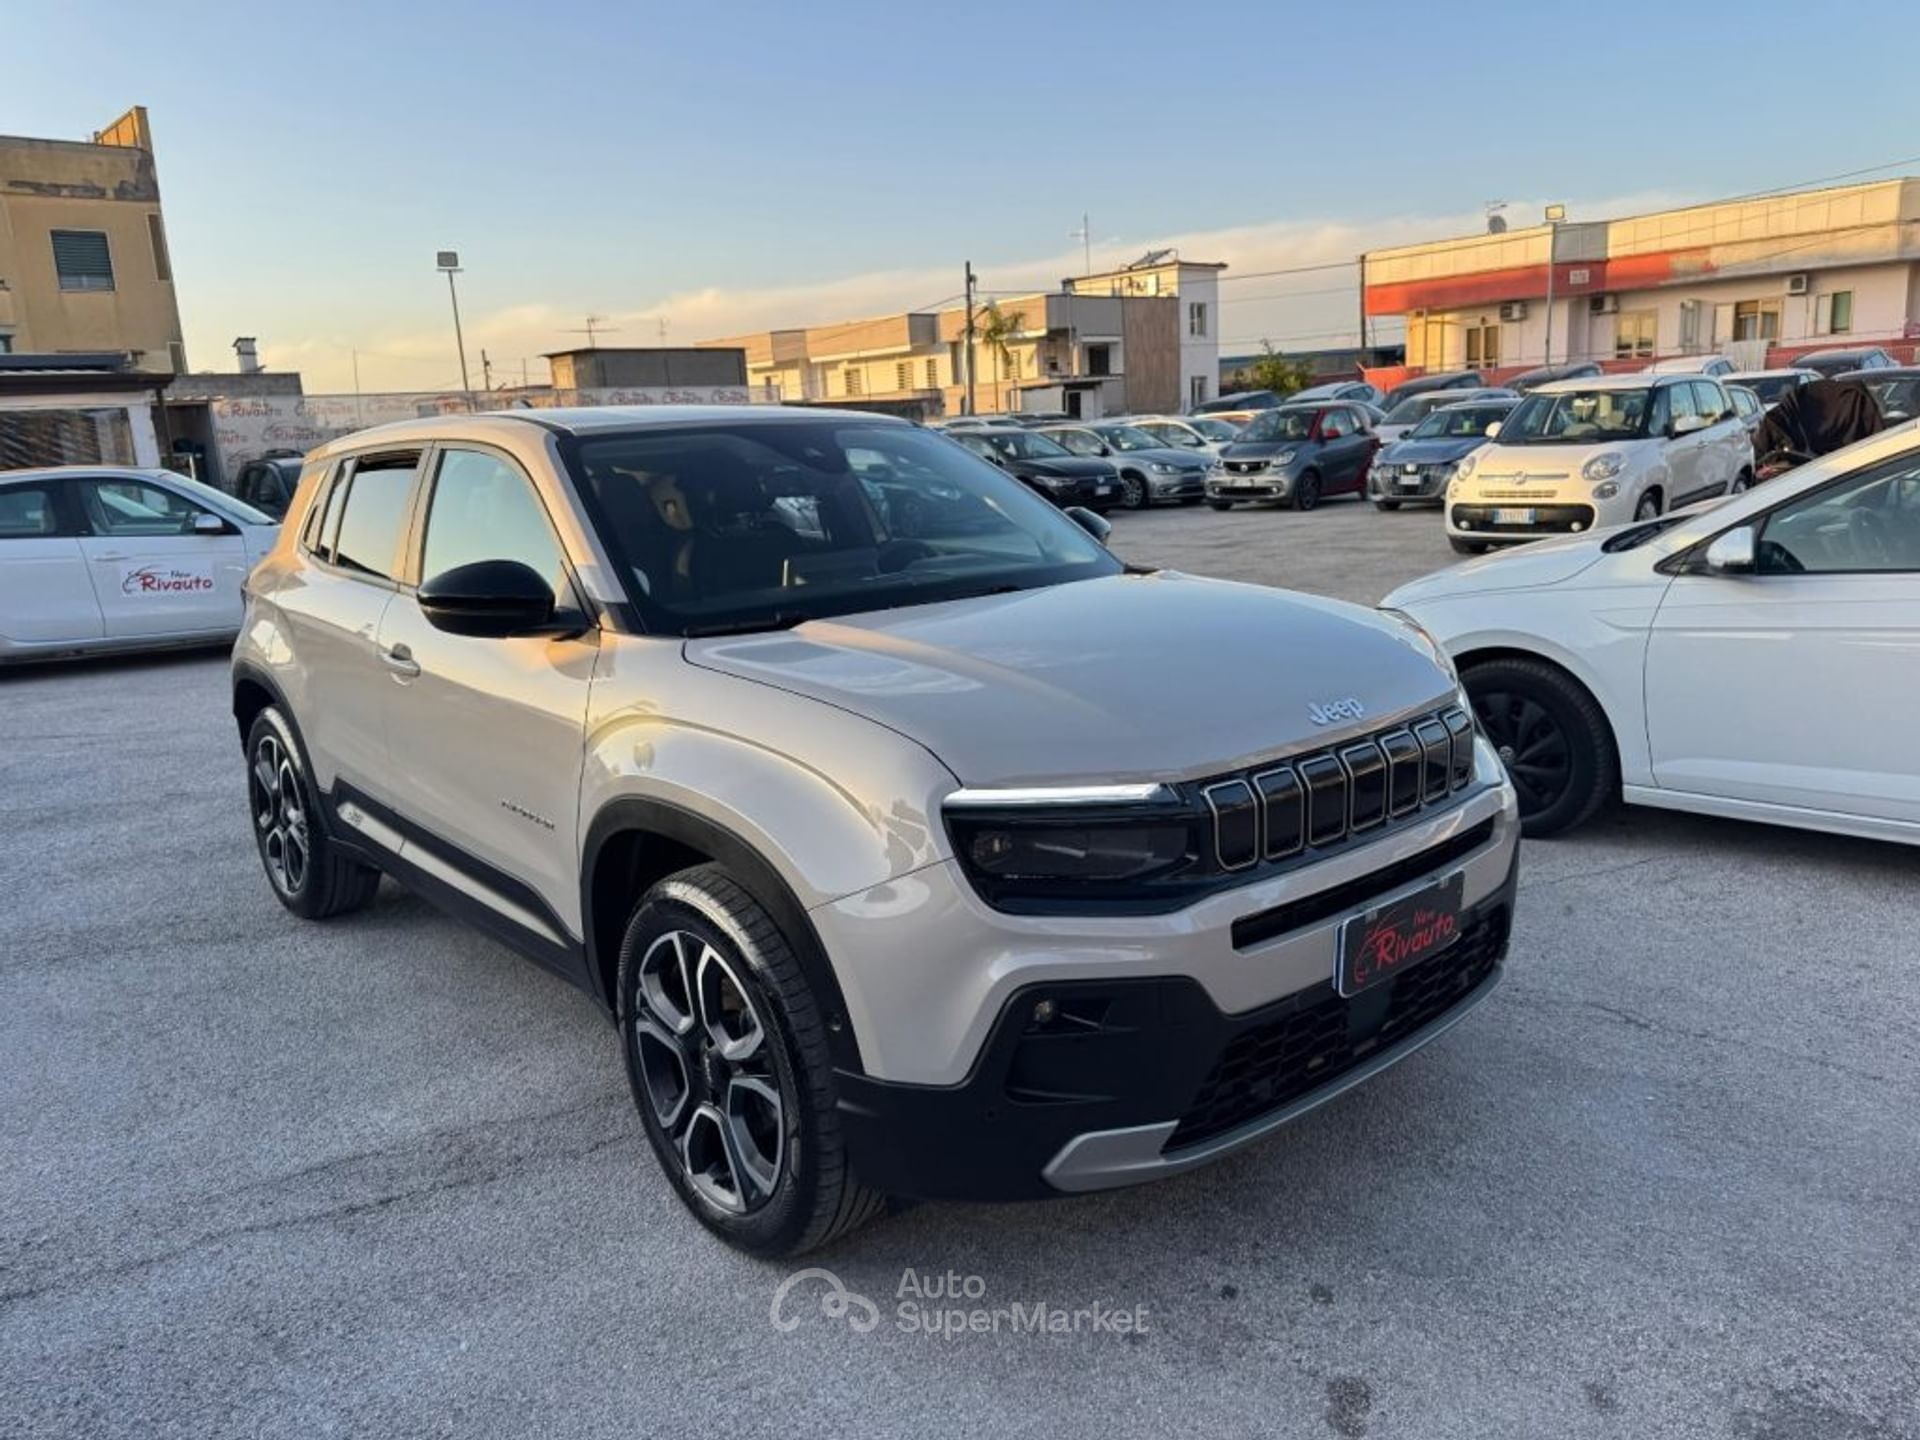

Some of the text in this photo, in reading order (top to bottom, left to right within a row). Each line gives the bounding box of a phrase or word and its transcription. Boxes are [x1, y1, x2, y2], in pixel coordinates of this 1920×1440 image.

[139, 574, 213, 591] Rivauto
[1306, 698, 1364, 726] Jeep
[1374, 914, 1455, 970] Rivauto
